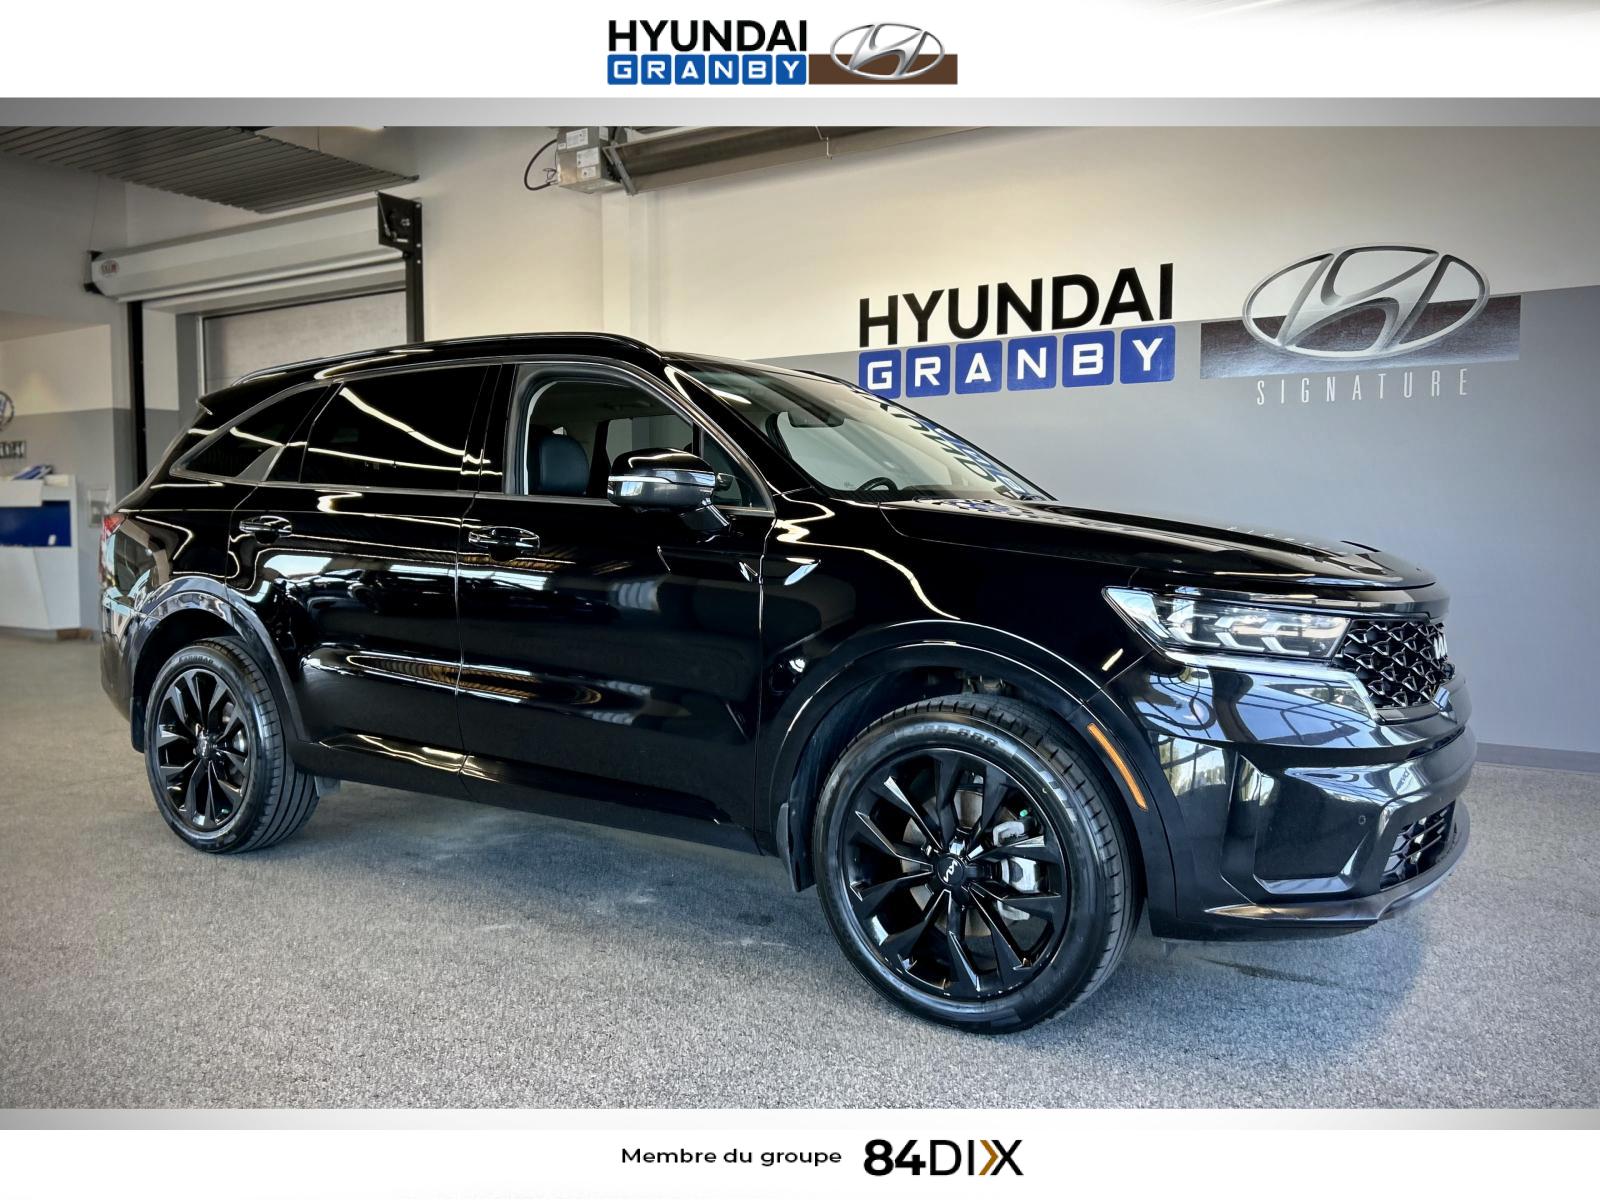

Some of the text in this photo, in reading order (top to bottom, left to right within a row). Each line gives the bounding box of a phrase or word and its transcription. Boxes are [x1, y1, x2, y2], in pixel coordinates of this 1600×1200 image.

[859, 263, 1173, 348] HYUNDAI
[866, 337, 1164, 391] GRANBY
[1256, 368, 1469, 406] SIGNATURE
